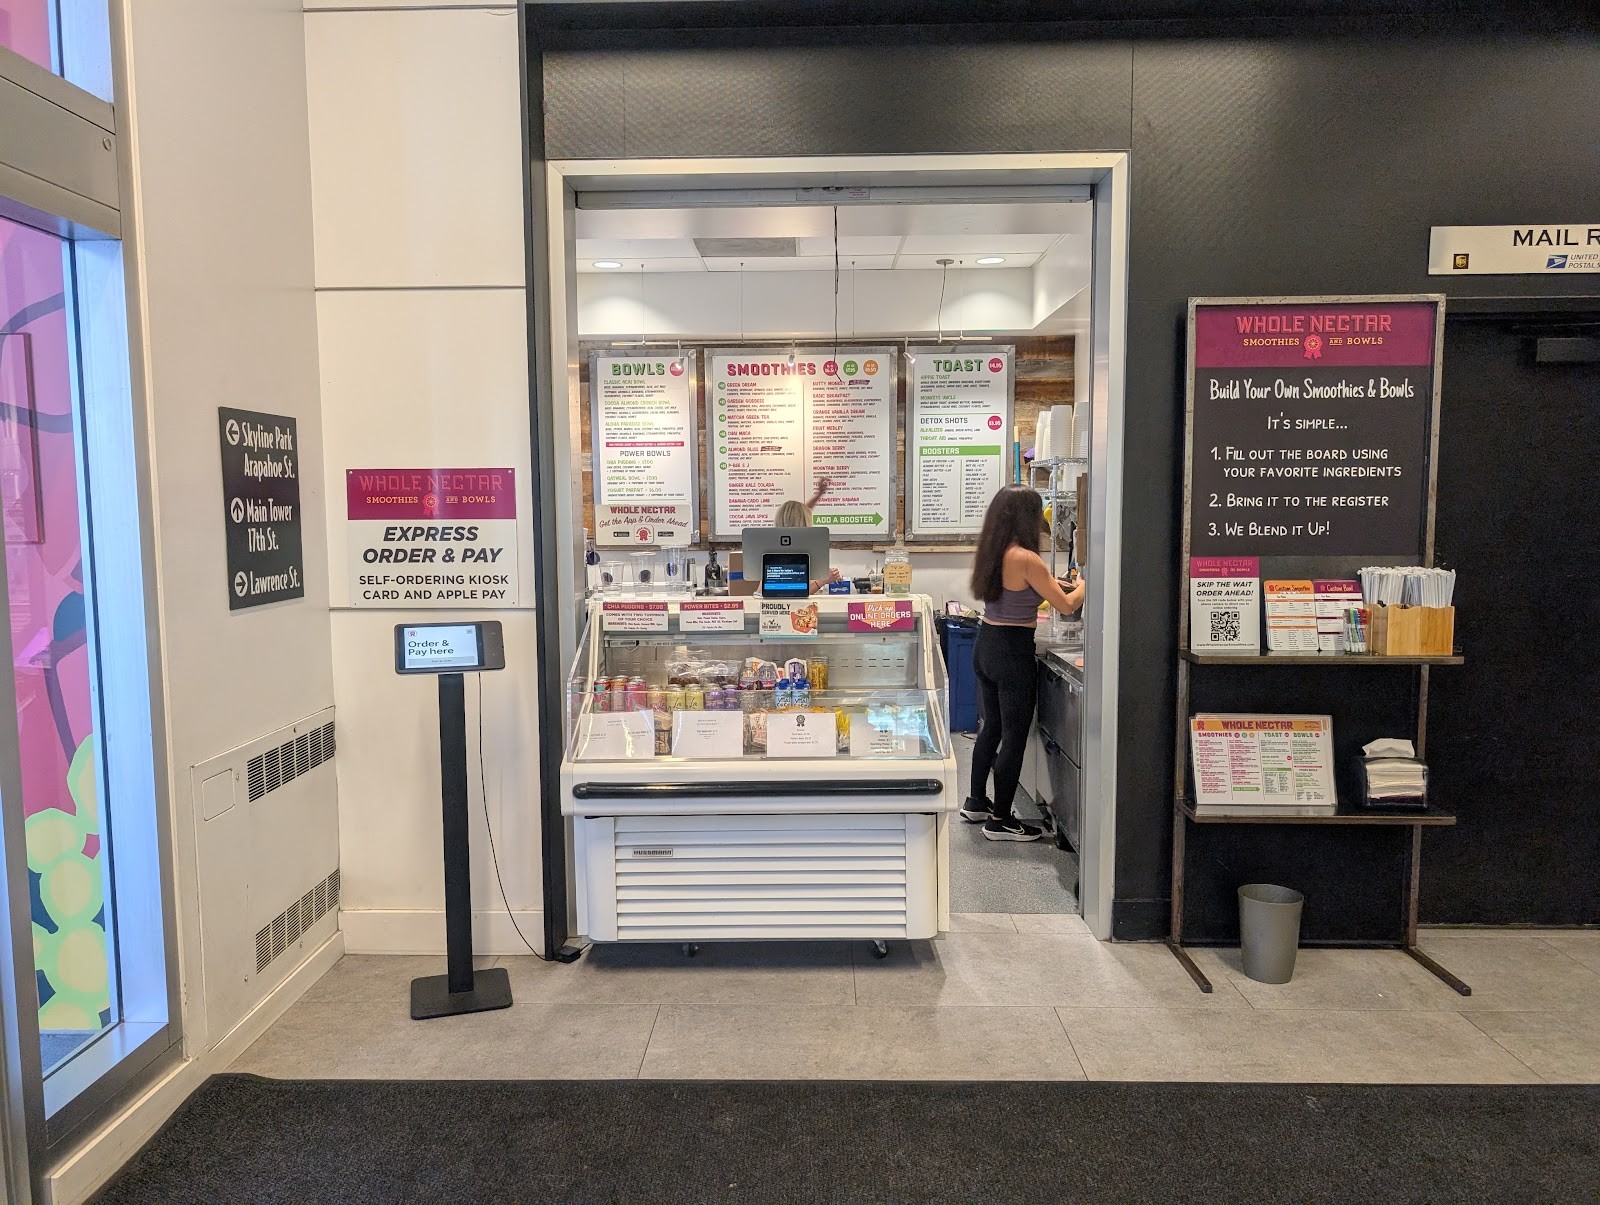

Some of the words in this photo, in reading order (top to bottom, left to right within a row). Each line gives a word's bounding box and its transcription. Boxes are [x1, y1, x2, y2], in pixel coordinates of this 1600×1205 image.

[1512, 229, 1579, 247] MAIL
[1235, 315, 1305, 334] WHOLE
[1309, 314, 1392, 333] NECTAR
[1243, 338, 1300, 346] SMOOTHIES
[1329, 337, 1343, 345] AND
[1347, 337, 1383, 345] BOWLS
[611, 363, 665, 376] BOWLS
[727, 362, 817, 377] SMOOTHIES
[932, 359, 984, 372] TOAST
[1209, 378, 1240, 400] Build
[1243, 378, 1271, 399] Your
[1274, 379, 1300, 399] Own
[1303, 378, 1364, 399] Smoothies
[1367, 379, 1376, 398] &
[1379, 377, 1414, 398] Bowls
[241, 421, 274, 452] Skyline
[275, 426, 293, 451] Park
[922, 447, 960, 455] BOOSTERS
[1210, 446, 1222, 460] 1.
[1249, 449, 1275, 460] OUT
[1279, 449, 1302, 460] THE
[1306, 449, 1347, 460] BOARD
[1352, 449, 1388, 460] USING
[244, 452, 283, 482] Arapahoe
[283, 455, 295, 479] St.
[1223, 467, 1255, 478] YOUR
[1260, 467, 1319, 478] FAVORITE
[1323, 466, 1402, 477] INGREDIENTS
[359, 475, 422, 492] WHOLE
[427, 474, 504, 492] NECTAR
[366, 496, 419, 504] SMOOTHIES
[462, 495, 496, 503] BOWLS
[1208, 493, 1222, 507] 2.
[1226, 493, 1263, 507] BRING
[1267, 497, 1279, 507] IT
[1283, 496, 1300, 507] TO
[1305, 496, 1327, 507] THE
[1331, 496, 1389, 507] REGISTER
[246, 498, 268, 523] Main
[268, 499, 293, 522] Tower
[610, 506, 640, 514] WHOLE
[641, 506, 676, 514] NECTAR
[599, 519, 611, 528] Get
[612, 517, 622, 526] the
[623, 516, 637, 526] App
[666, 517, 689, 528] Ahead
[815, 516, 831, 524] ADD
[383, 526, 479, 542] EXPRESS
[1208, 522, 1221, 536] 3.
[1248, 522, 1288, 536] BLEND
[1292, 525, 1304, 536] IT
[247, 527, 266, 552] 17th
[267, 527, 279, 551] St.
[362, 548, 437, 563] ORDER
[441, 548, 456, 563] &
[461, 548, 504, 563] PAY
[1223, 559, 1253, 567] NECTAR
[250, 570, 288, 595] Lawrence
[289, 565, 300, 588] St.
[359, 575, 465, 585] SELF-ORDERING
[469, 575, 509, 585] KIOSK
[363, 590, 400, 600] CARD
[403, 590, 432, 600] AND
[436, 590, 478, 600] APPLE
[482, 589, 506, 599] PAY
[1326, 584, 1342, 592] Custom
[850, 612, 880, 621] ONLINE
[880, 611, 911, 620] ORDERS
[870, 620, 891, 628] HERE
[408, 640, 440, 648] Order
[441, 639, 450, 647] &
[408, 648, 428, 657] Pay
[429, 647, 454, 655] here
[1221, 720, 1255, 730] WHOLE
[1255, 720, 1294, 730] NECTAR
